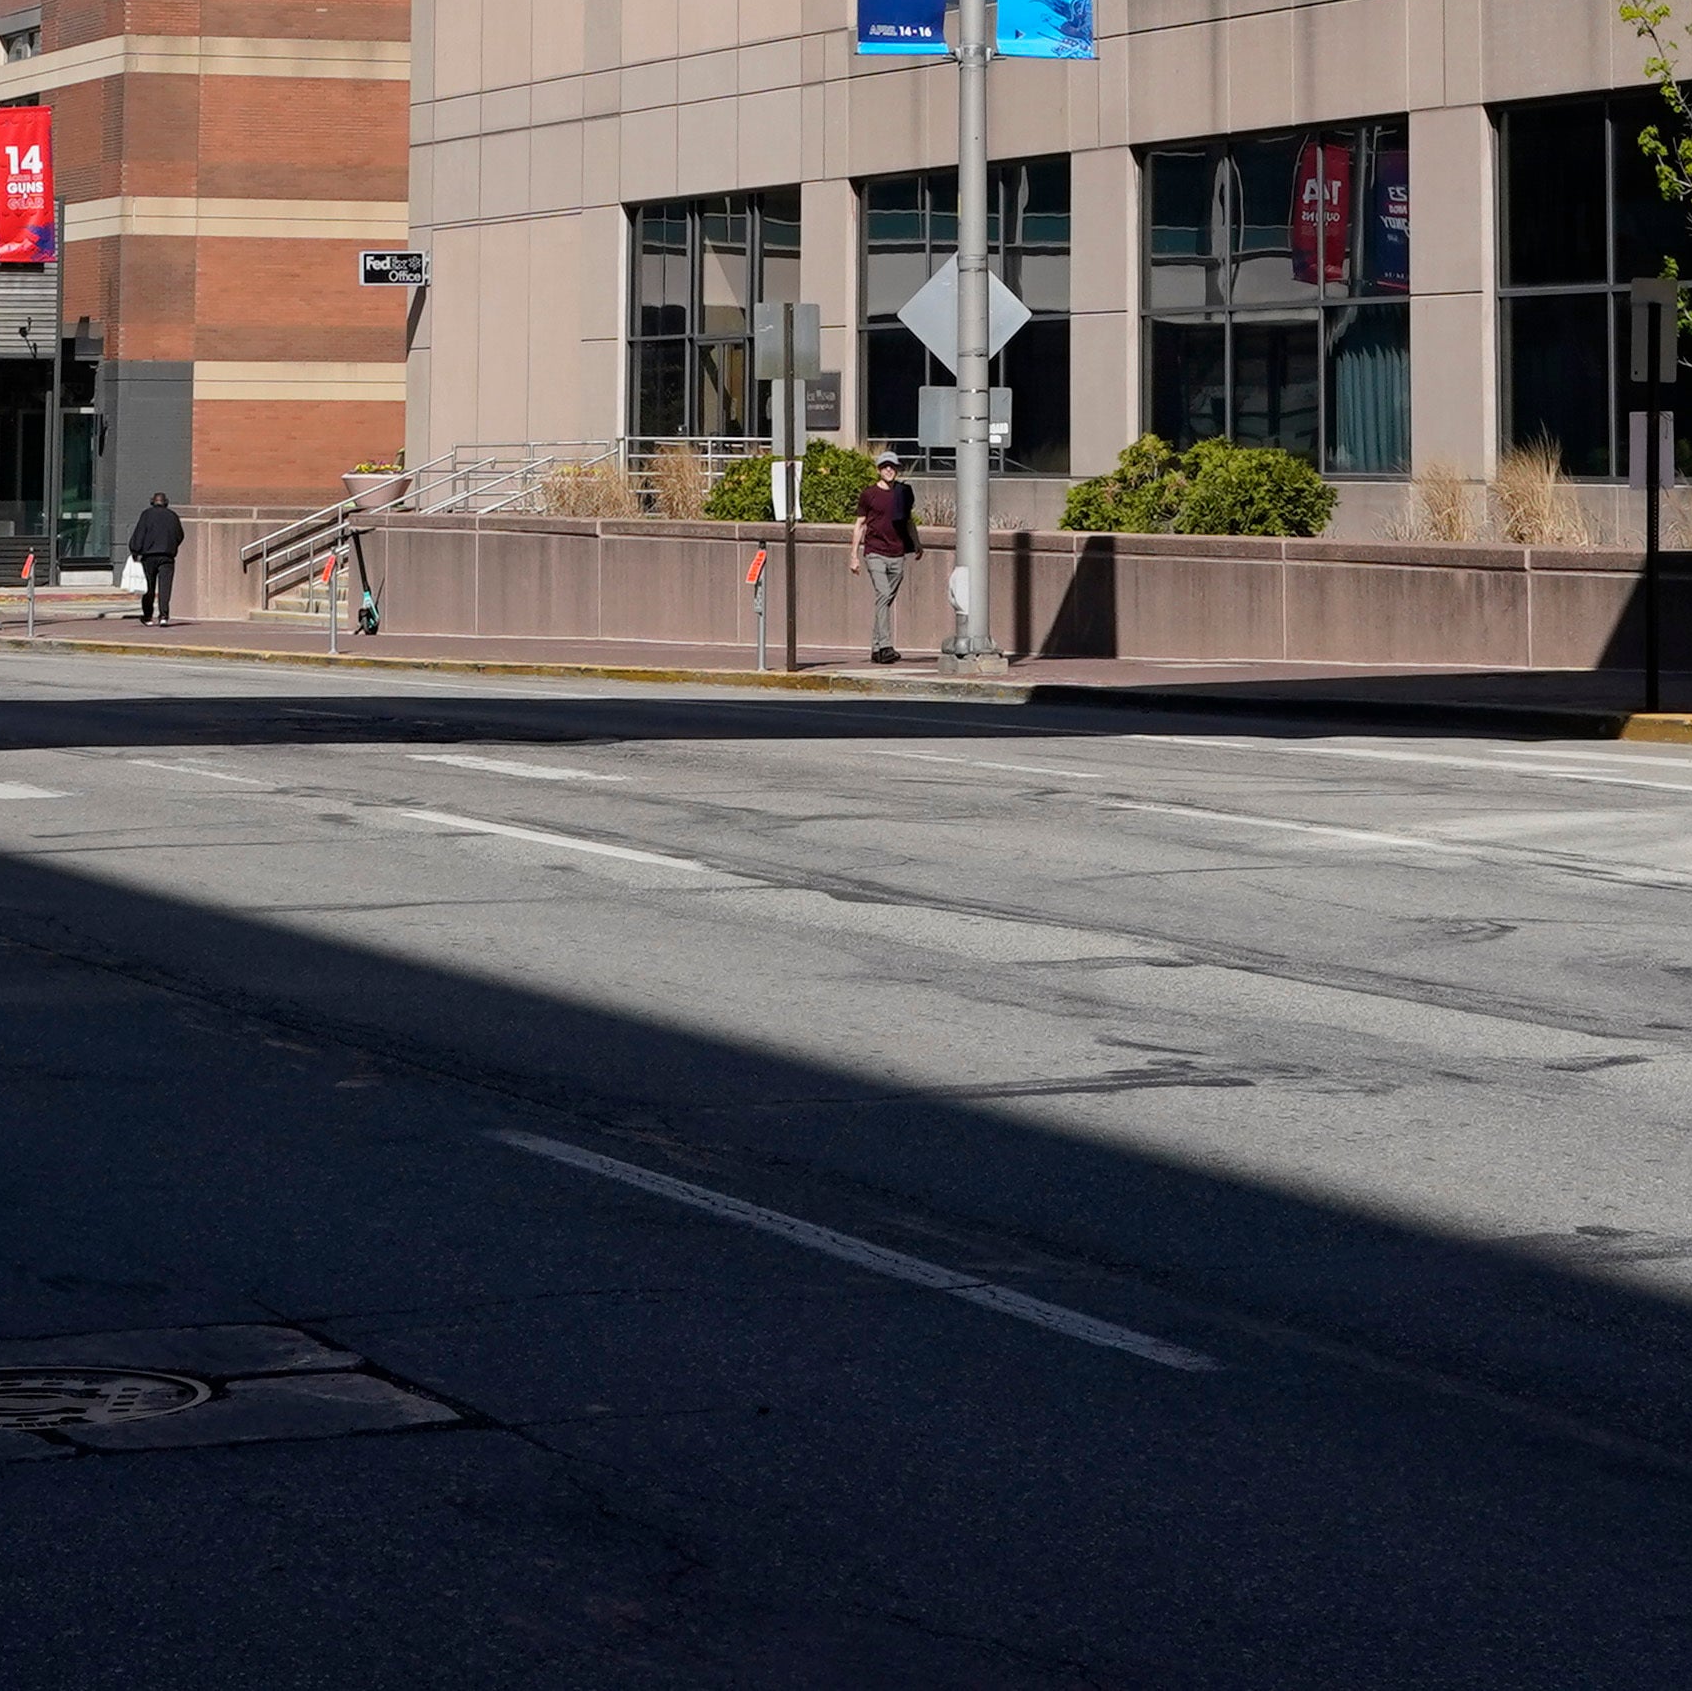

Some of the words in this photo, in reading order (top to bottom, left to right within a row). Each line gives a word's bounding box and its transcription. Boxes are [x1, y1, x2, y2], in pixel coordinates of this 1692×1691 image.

[5, 145, 43, 174] 14
[6, 181, 44, 194] GUNS
[365, 256, 407, 270] FedEx
[389, 270, 421, 282] Office
